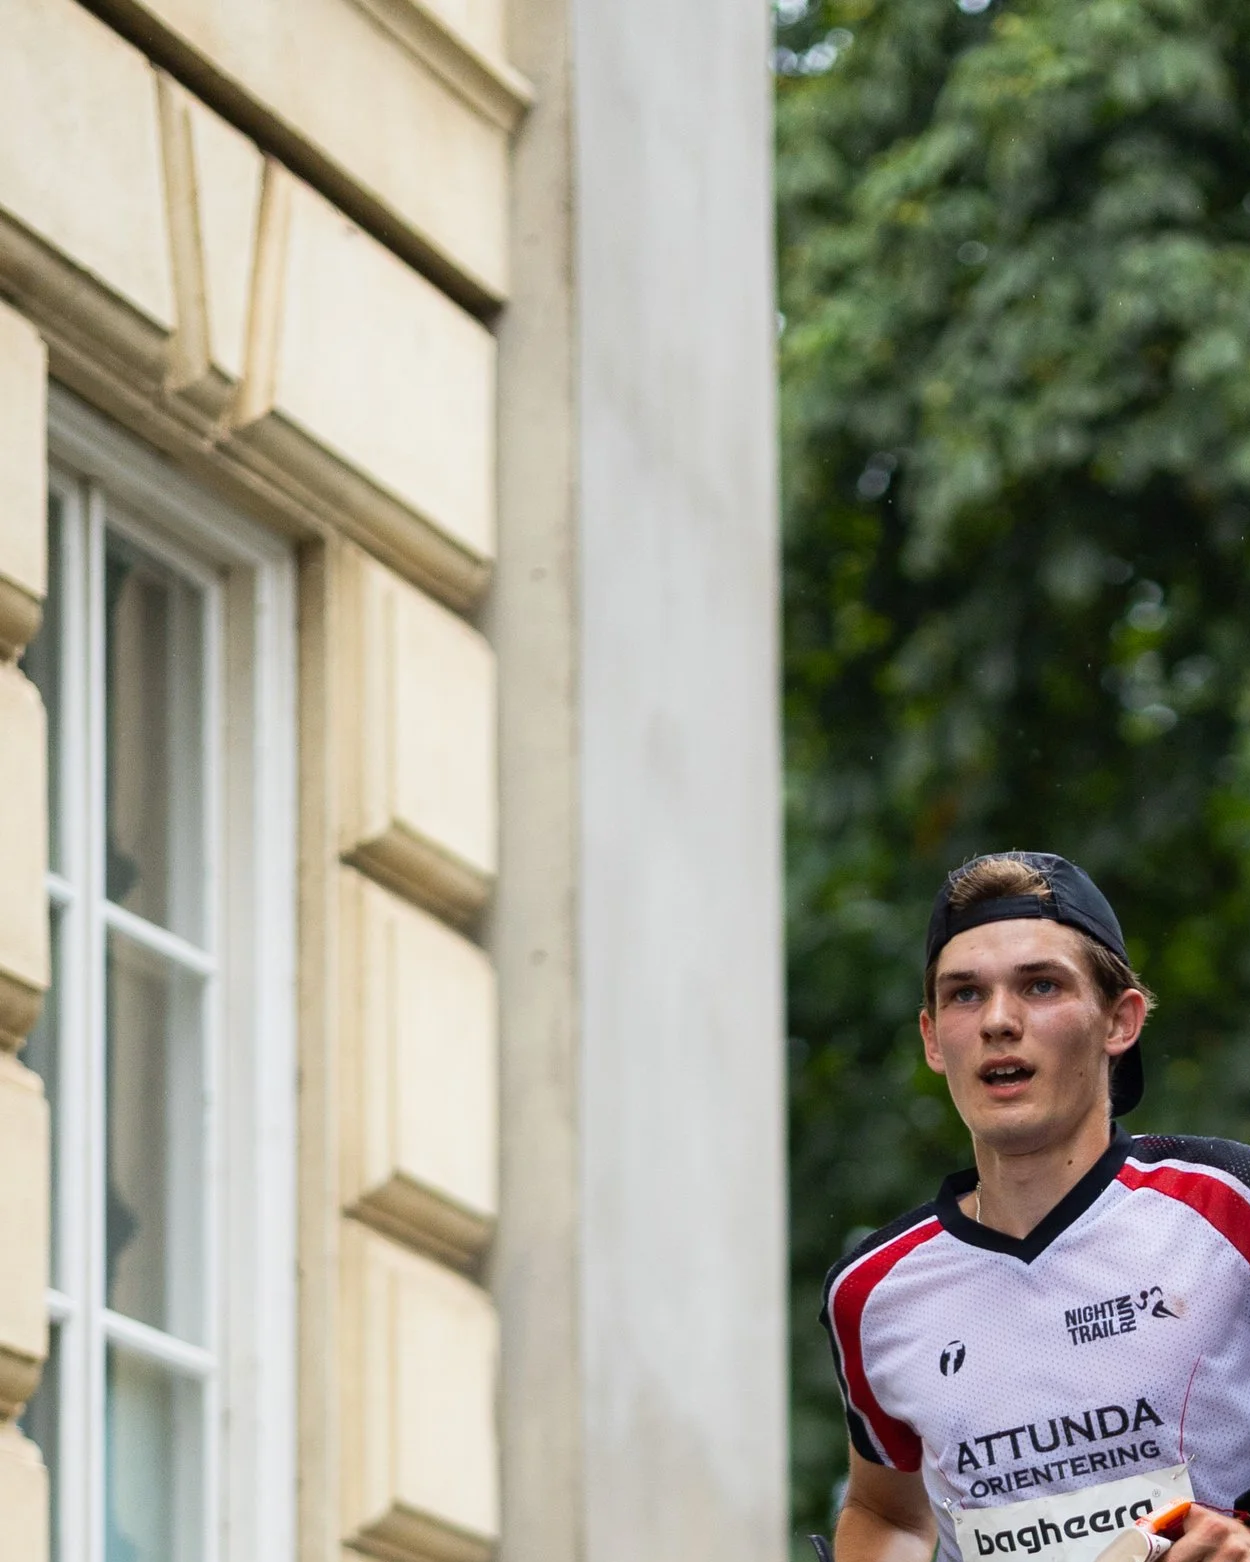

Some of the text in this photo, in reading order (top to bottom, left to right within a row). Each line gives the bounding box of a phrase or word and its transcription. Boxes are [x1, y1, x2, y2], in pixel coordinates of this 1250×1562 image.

[1064, 1299, 1115, 1328] NIGHT
[1067, 1318, 1121, 1346] TRAIL
[1115, 1294, 1137, 1334] RUN
[957, 1397, 1165, 1474] ATTUNDA
[970, 1439, 1162, 1499] ORIENTERING
